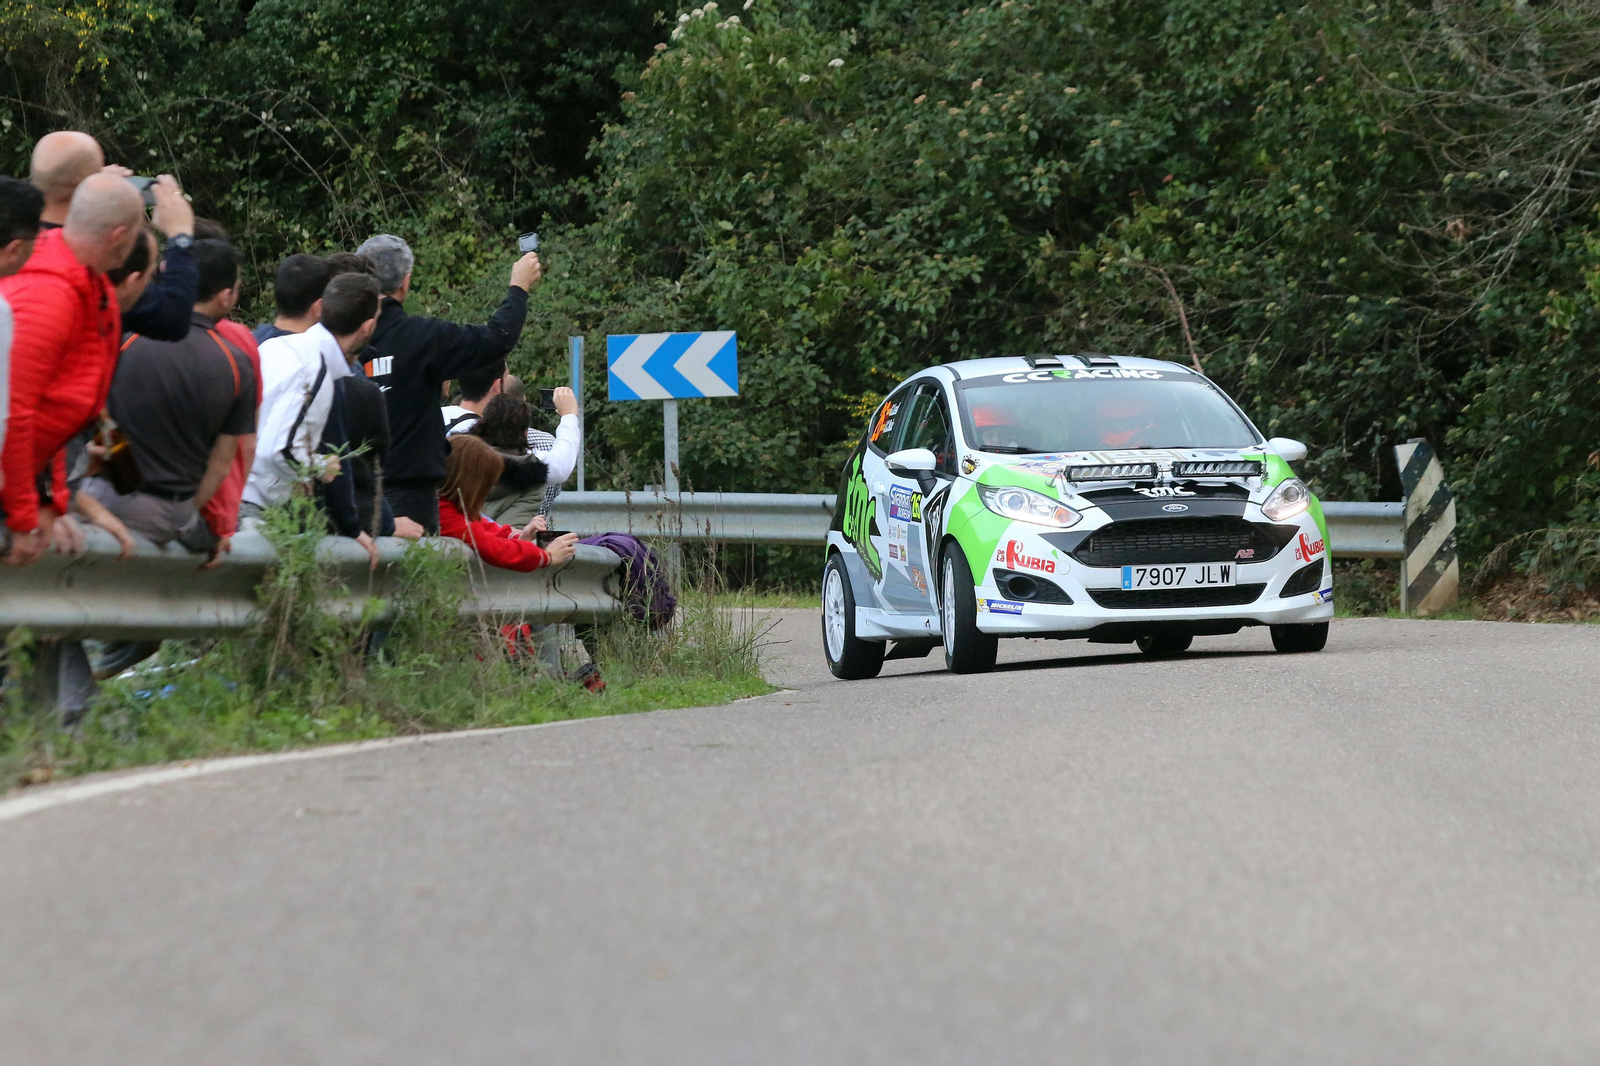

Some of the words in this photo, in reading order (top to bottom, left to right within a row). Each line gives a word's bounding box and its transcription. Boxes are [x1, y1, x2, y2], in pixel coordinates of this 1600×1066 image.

[911, 493, 921, 519] 26
[1136, 567, 1186, 587] 7907
[1194, 565, 1231, 584] JLW
[990, 602, 1024, 611] MICHELIN
